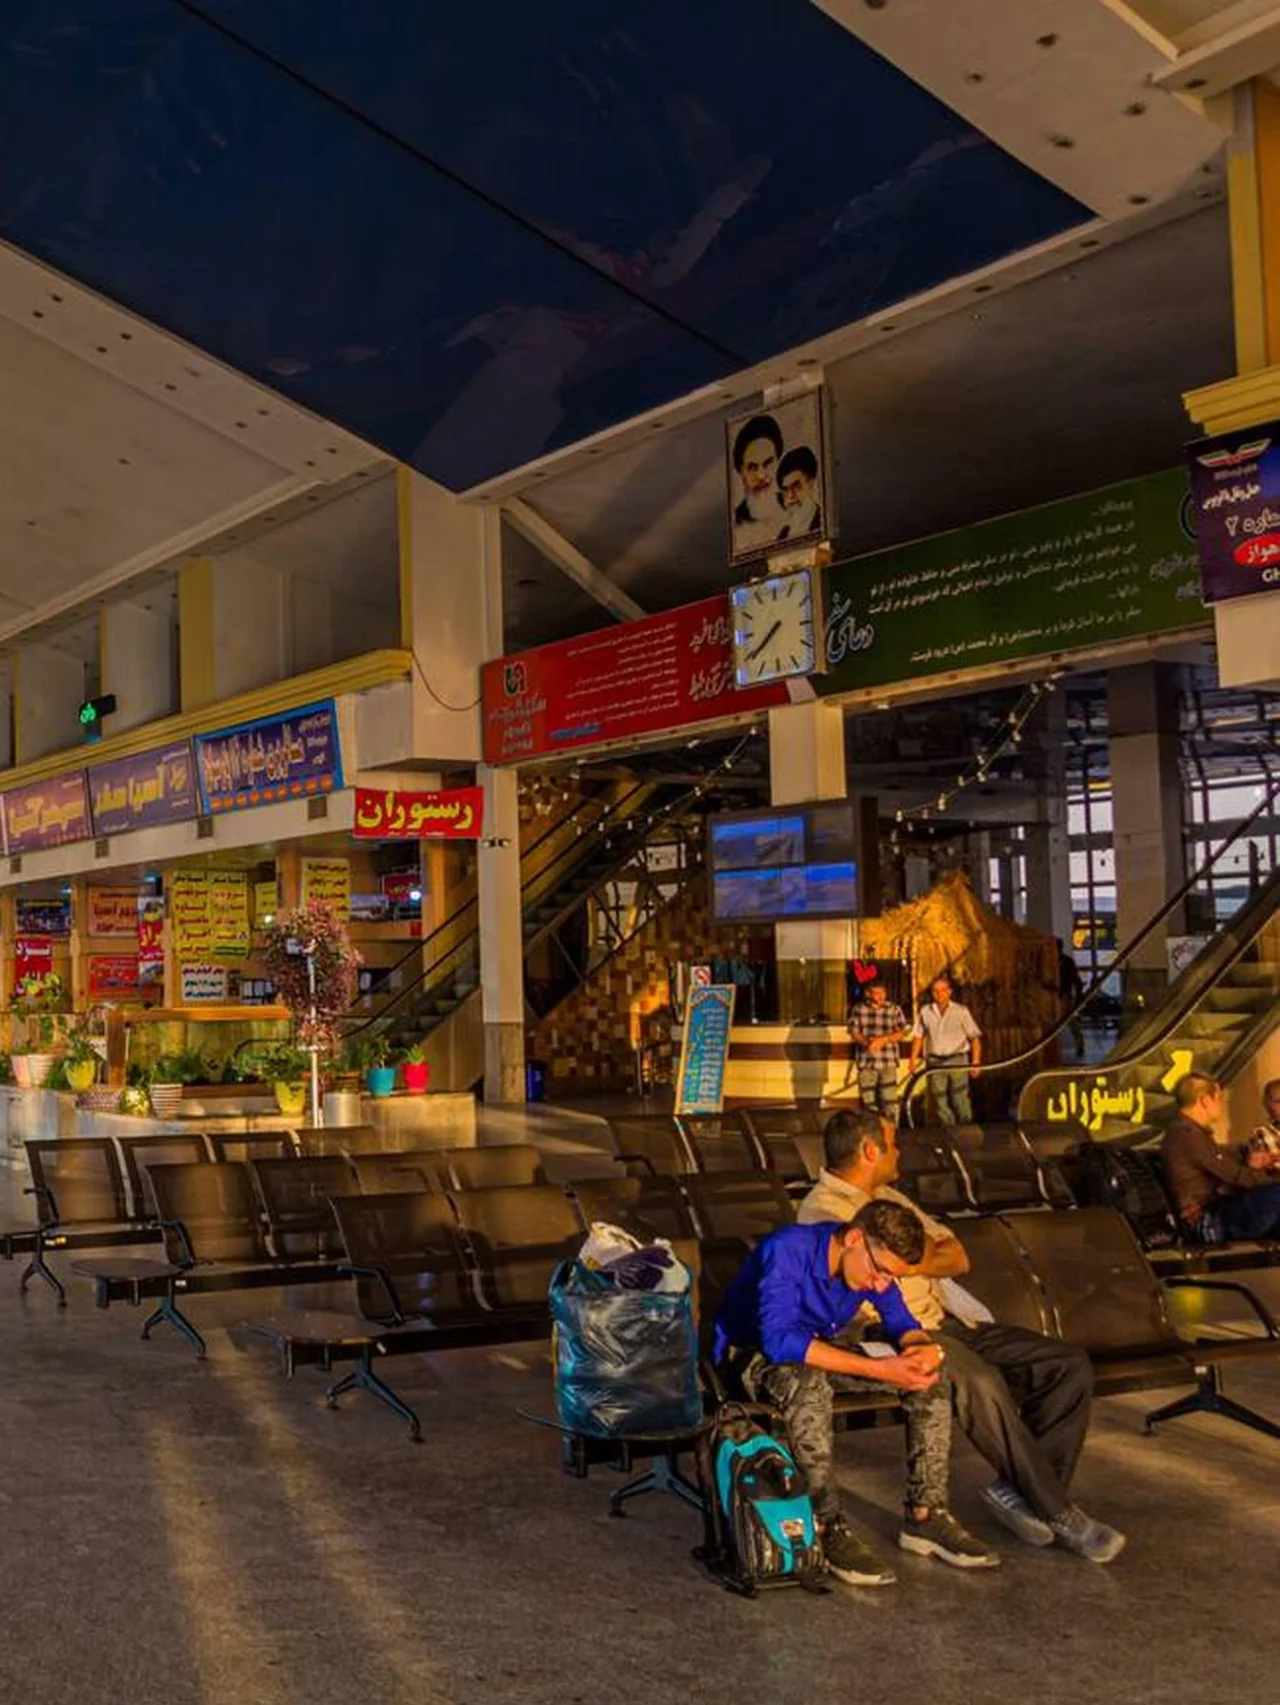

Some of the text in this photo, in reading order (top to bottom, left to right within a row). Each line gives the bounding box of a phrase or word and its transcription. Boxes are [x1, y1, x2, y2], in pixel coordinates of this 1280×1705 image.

[94, 782, 127, 817] سفر
[128, 759, 167, 812] آسیا
[357, 790, 473, 829] رستوران
[1047, 1076, 1145, 1131] رستوران
